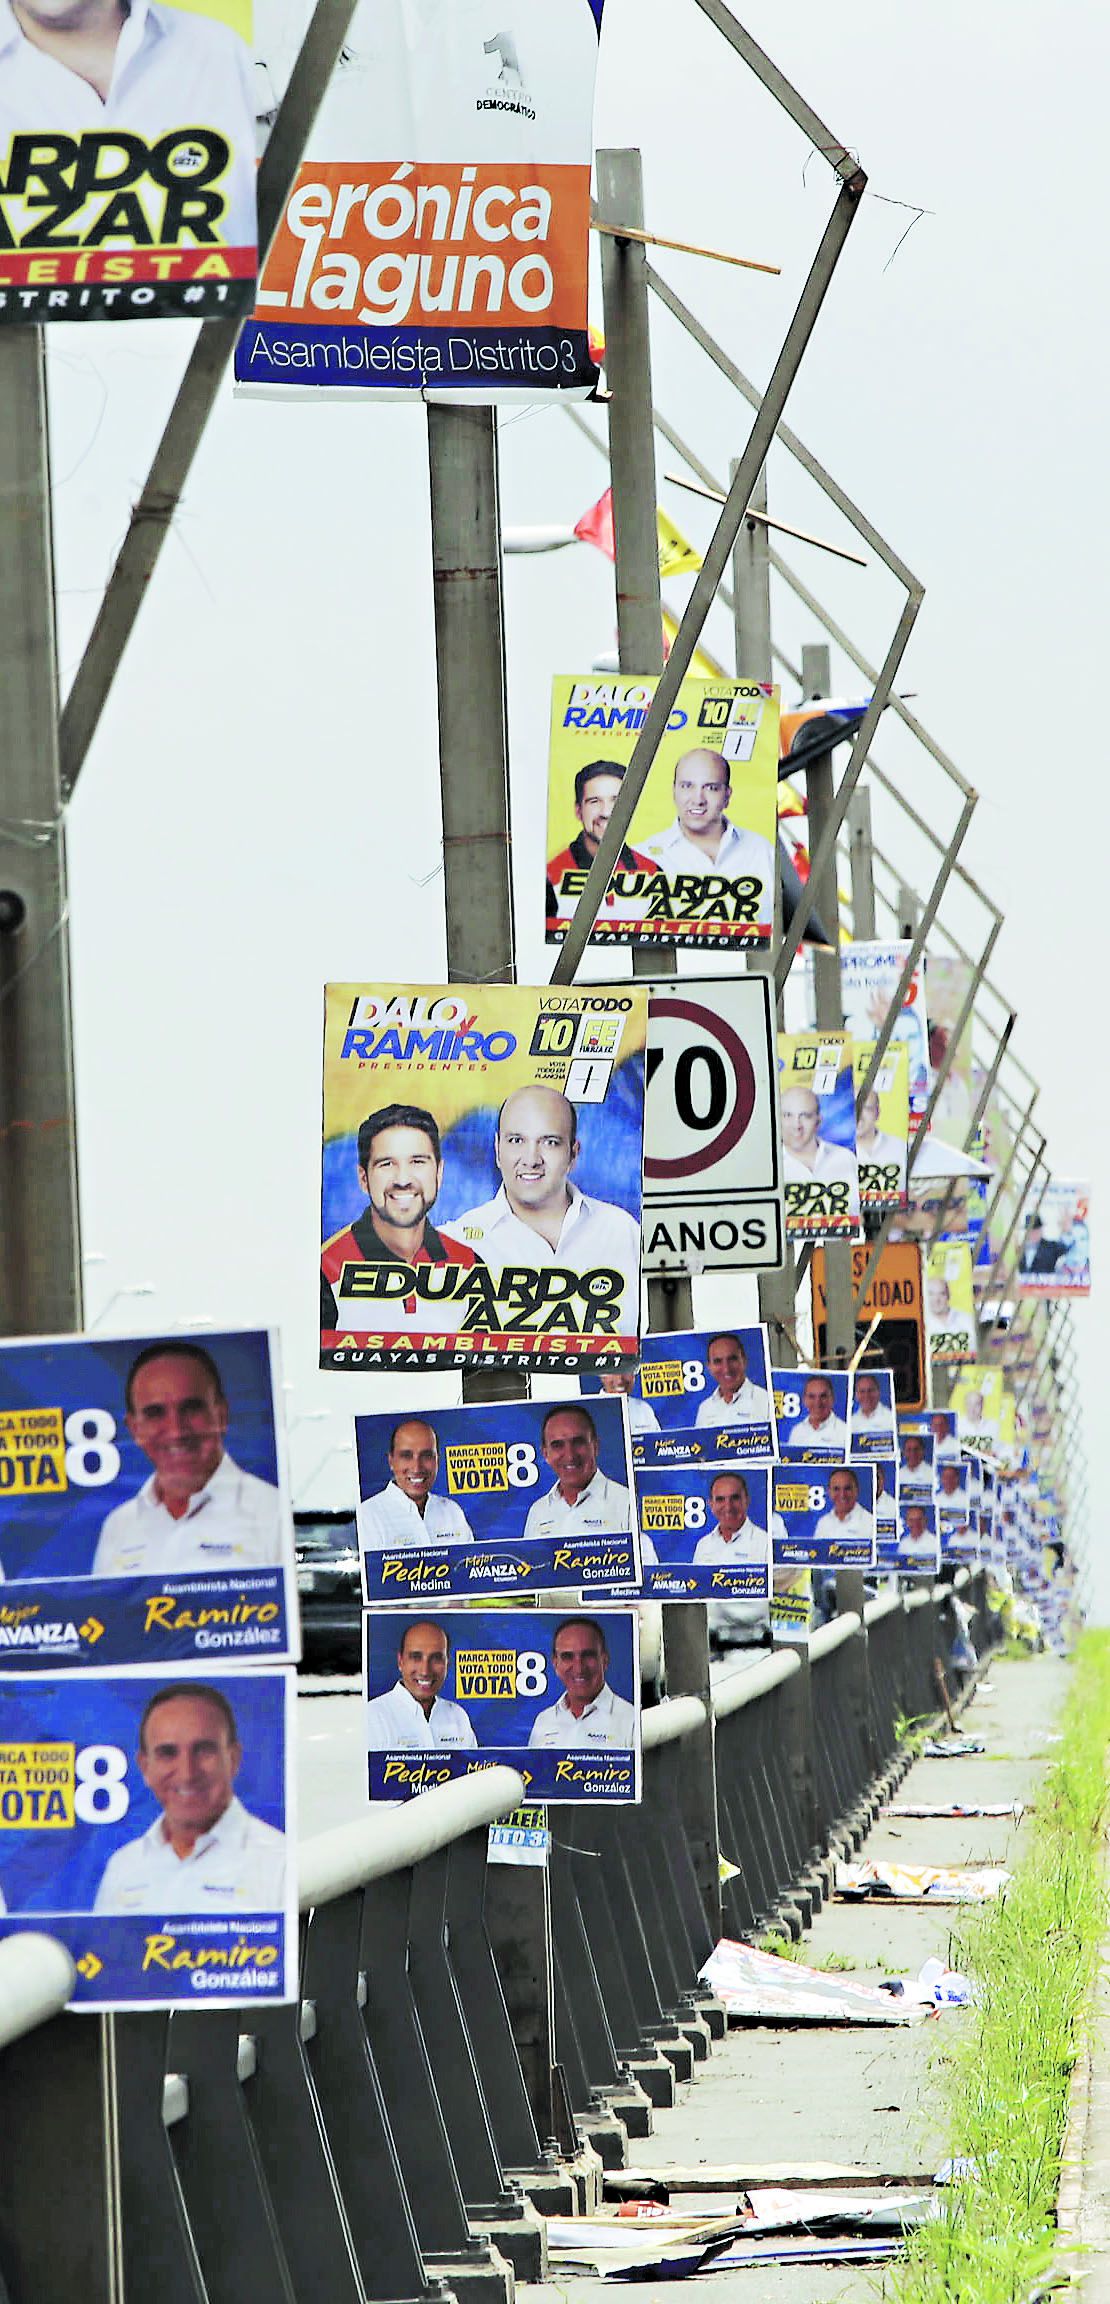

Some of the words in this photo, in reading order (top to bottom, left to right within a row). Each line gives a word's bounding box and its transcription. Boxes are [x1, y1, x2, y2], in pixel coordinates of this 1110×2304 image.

[0, 129, 229, 195] RDO
[286, 163, 551, 242] erónica
[183, 284, 228, 304] #1
[250, 332, 442, 373] Asambleísta
[568, 684, 651, 706] DALO
[563, 707, 687, 730] RAMIO
[702, 701, 729, 724] 10
[560, 871, 763, 900] EUARDO
[645, 895, 760, 921] AZAR
[554, 932, 627, 942] GYAS
[640, 933, 730, 945] DISTRITO
[558, 920, 760, 935] AAMBLEÍSTA
[349, 996, 469, 1028] DALO
[340, 1028, 517, 1062] RAMIRO
[538, 1018, 574, 1052] 10
[358, 1061, 488, 1072] PRESIDENTES
[339, 1263, 625, 1302] EDUARDO
[461, 1297, 622, 1334] AZAR
[336, 1334, 623, 1353] ASAMBLEÍSTA
[333, 1352, 438, 1365] GUAYAS
[453, 1353, 579, 1367] DISTRITO
[594, 1356, 622, 1368] #1
[646, 1378, 682, 1394] VOTA
[683, 1360, 706, 1392] 8
[783, 1392, 801, 1418] 8
[64, 1408, 120, 1487] 8
[449, 1447, 479, 1458] MARCA
[480, 1447, 503, 1457] TODO
[716, 1432, 769, 1450] Ramiro
[450, 1459, 475, 1469] VOTA
[479, 1457, 504, 1467] TODO
[507, 1443, 538, 1487] 8
[452, 1468, 505, 1489] VOTA
[808, 1486, 826, 1510] 8
[647, 1514, 682, 1527] VOTA
[684, 1496, 707, 1529] 8
[554, 1548, 629, 1571] Ramiro
[382, 1560, 449, 1584] Pedro
[469, 1564, 517, 1579] AVANZA
[582, 1565, 631, 1579] González
[712, 1573, 765, 1590] Ramiro
[410, 1578, 451, 1591] Medina
[144, 1593, 279, 1633] Ramiro
[195, 1625, 281, 1649] González
[459, 1653, 489, 1663] MARCA
[491, 1653, 513, 1662] TODO
[459, 1664, 485, 1674] VOTA
[487, 1664, 513, 1674] TODO
[461, 1676, 512, 1695] VOTA
[516, 1651, 547, 1697] 8
[25, 1769, 70, 1784] TODO
[383, 1761, 451, 1784] Pedro
[555, 1760, 631, 1782] Ramiro
[75, 1744, 130, 1824] 8
[583, 1781, 631, 1793] González
[2, 1789, 68, 1822] OTA
[142, 1934, 278, 1972] Ramiro
[191, 1966, 279, 1990] González
